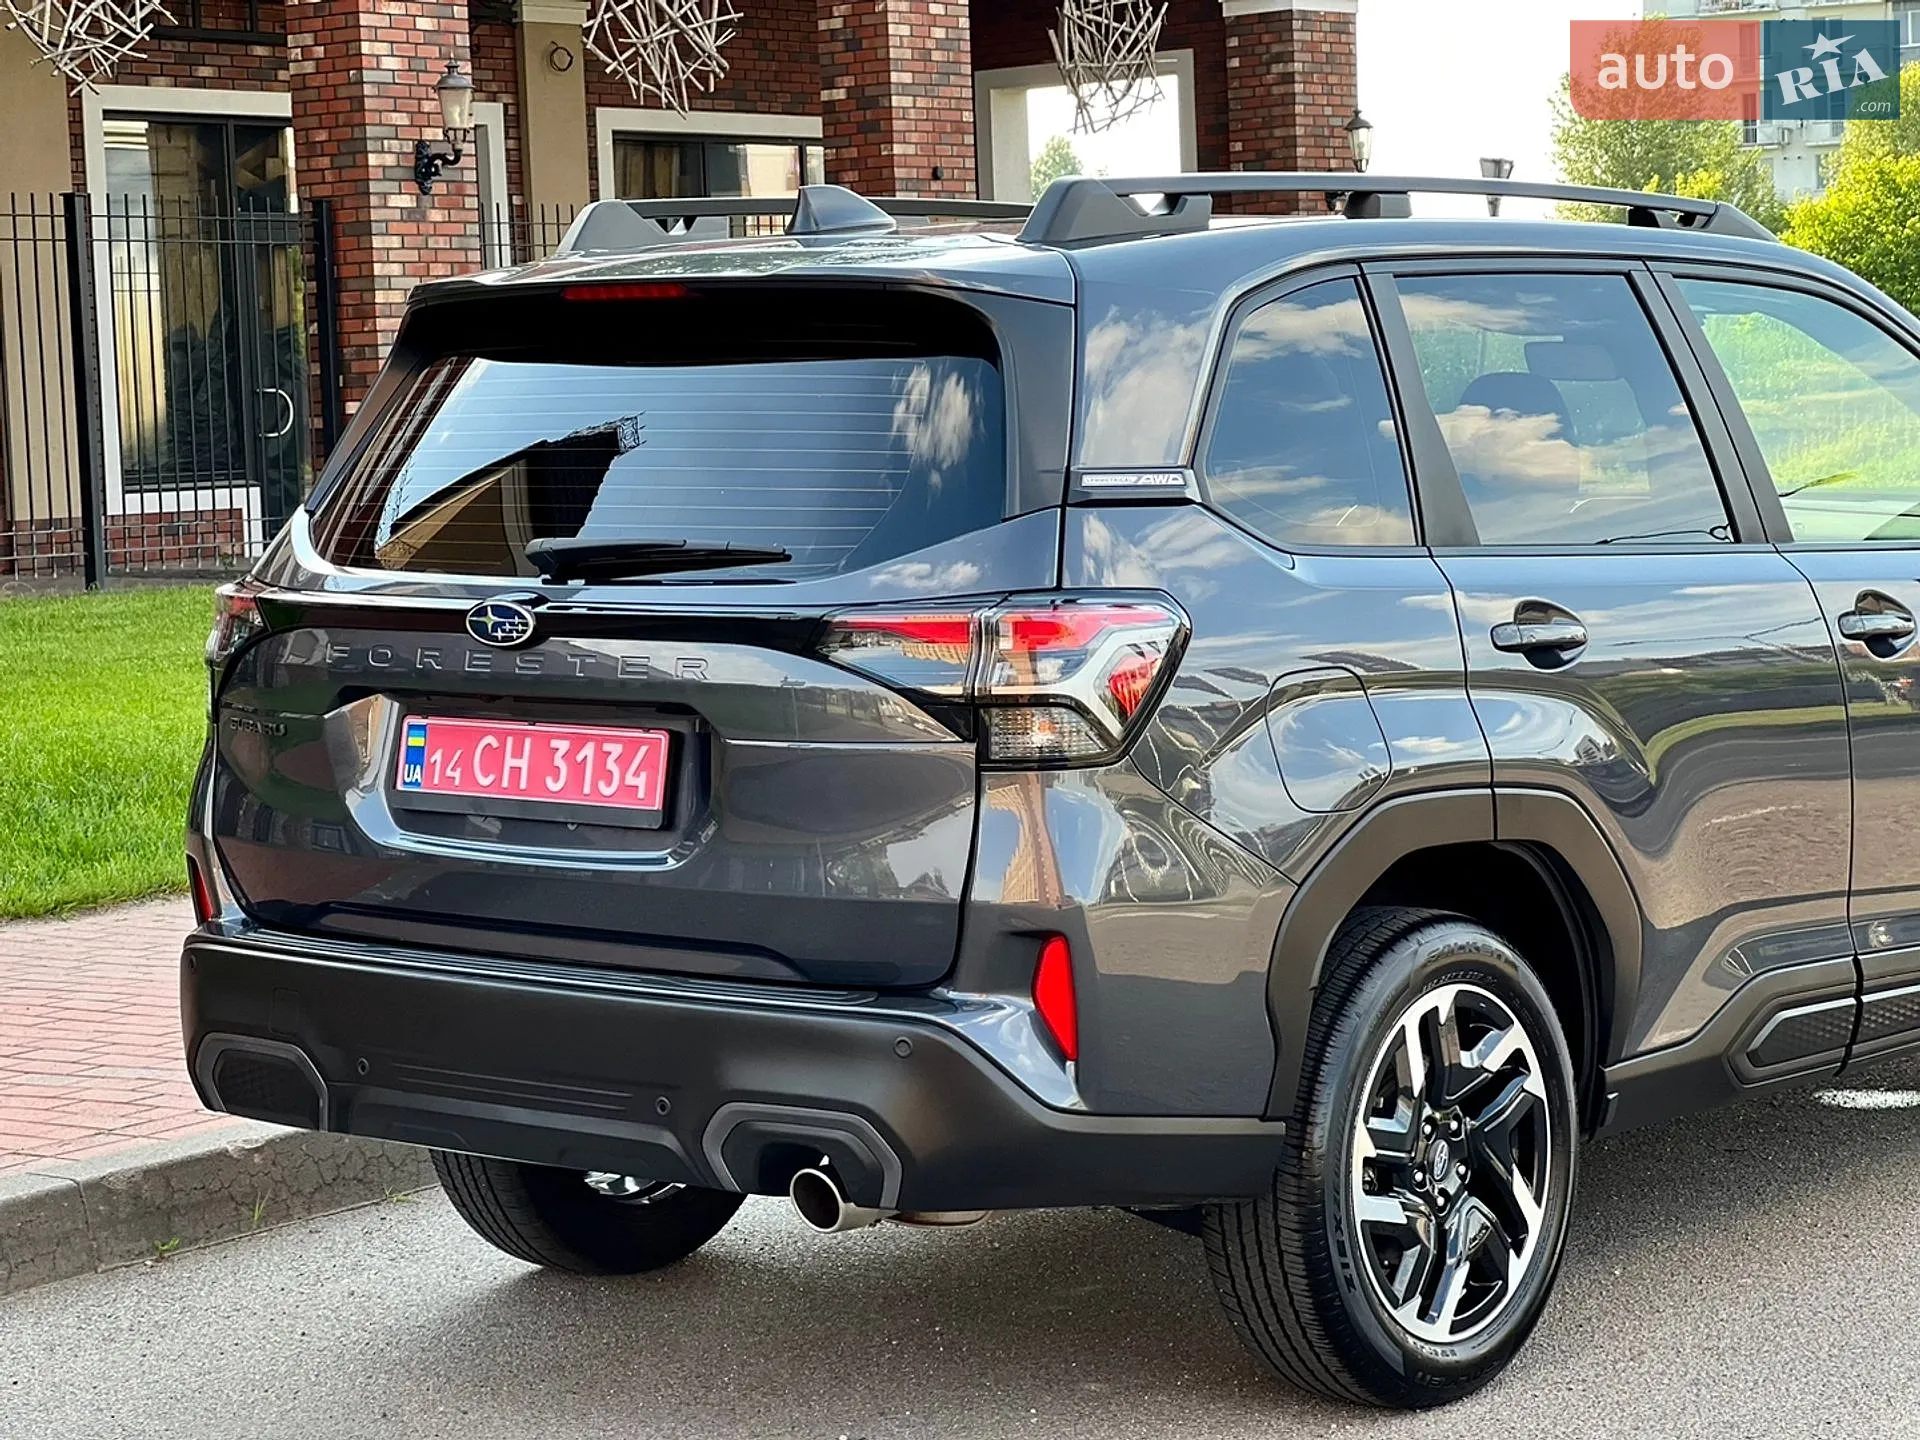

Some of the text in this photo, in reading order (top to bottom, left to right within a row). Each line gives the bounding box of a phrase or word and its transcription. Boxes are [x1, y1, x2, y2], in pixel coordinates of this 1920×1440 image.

[325, 642, 711, 681] FORESTER
[230, 717, 287, 736] SUBARU
[403, 763, 423, 784] UA
[429, 734, 650, 800] 14 CH 3134
